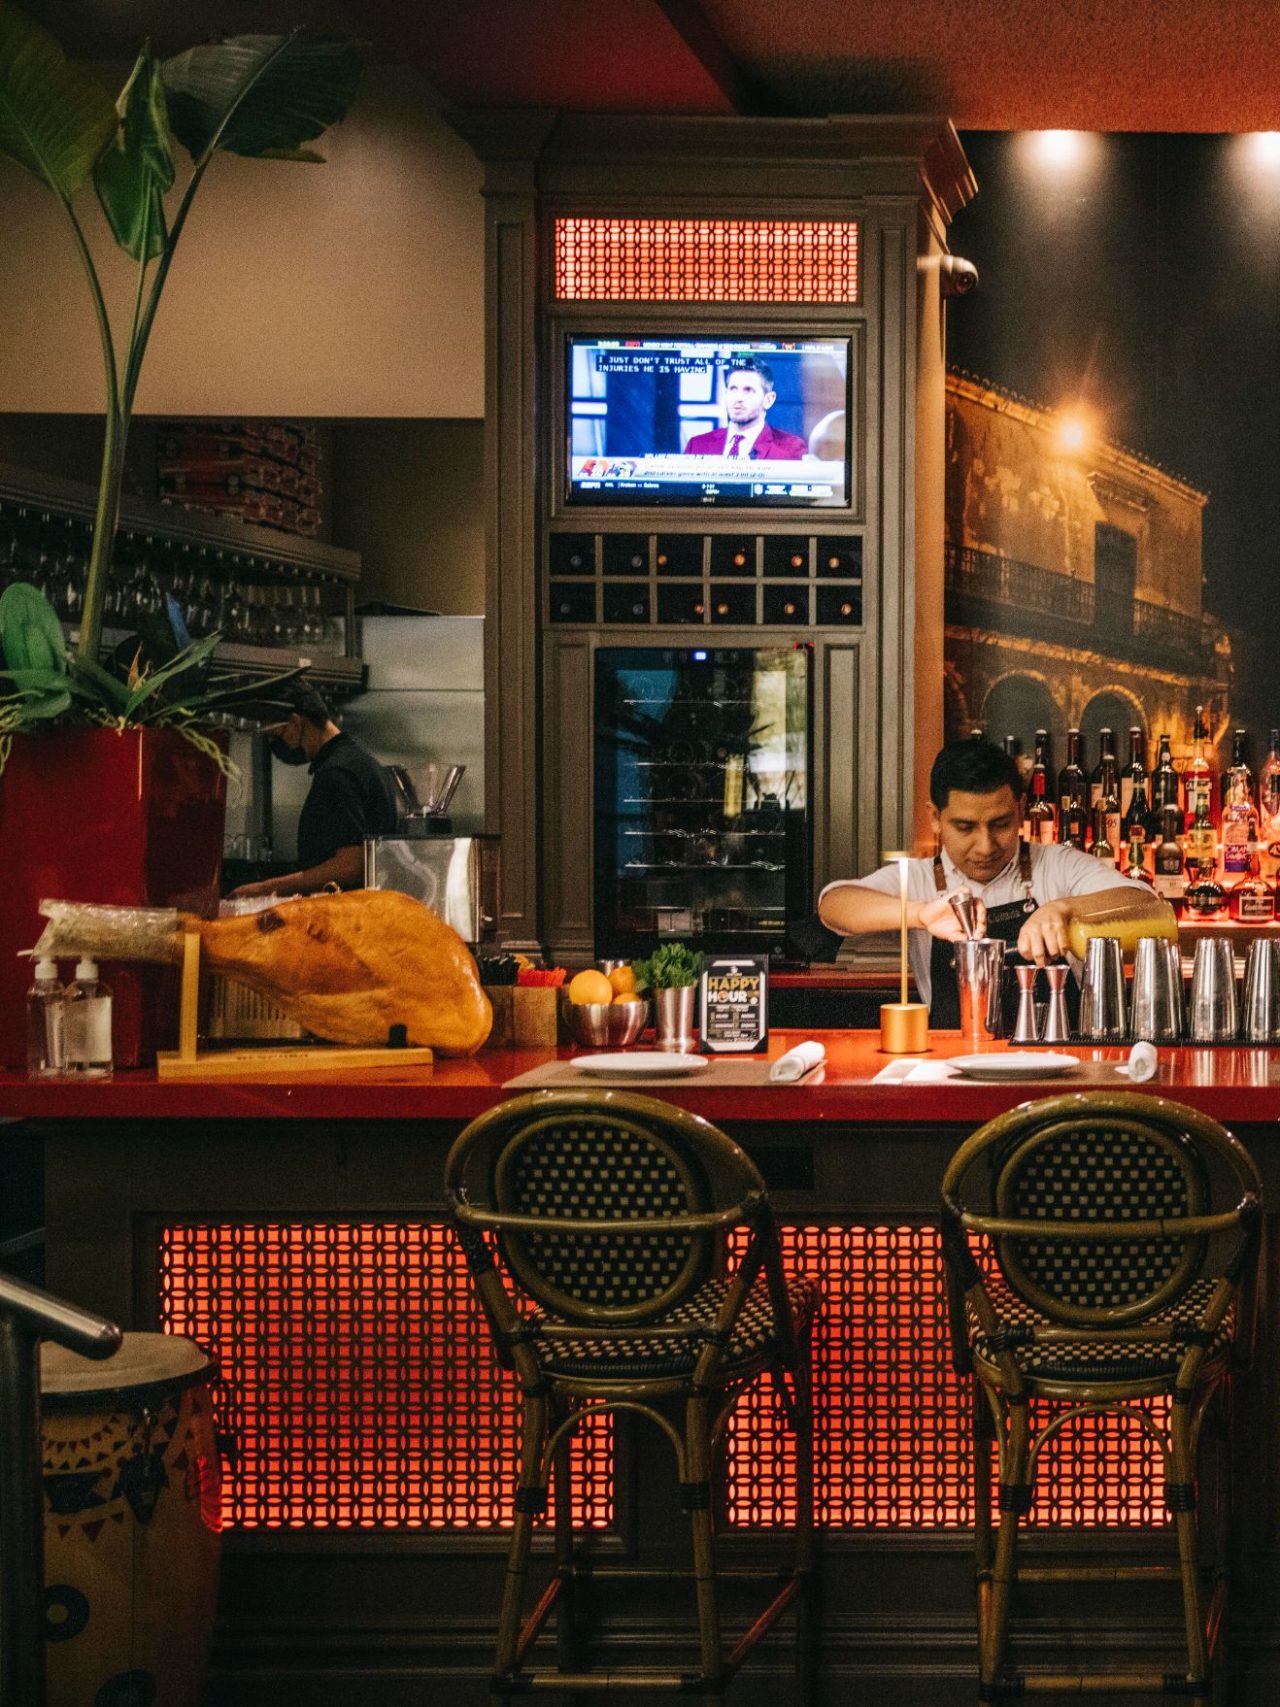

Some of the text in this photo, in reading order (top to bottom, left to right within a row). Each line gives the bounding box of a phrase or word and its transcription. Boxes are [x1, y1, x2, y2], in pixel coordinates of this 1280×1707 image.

[609, 356, 629, 364] JUST
[665, 357, 690, 365] TRUST
[731, 358, 746, 366] THE
[598, 364, 706, 373] INJURIES HE IS HAVING
[708, 977, 759, 989] HAPPY
[708, 990, 747, 1003] HOUR
